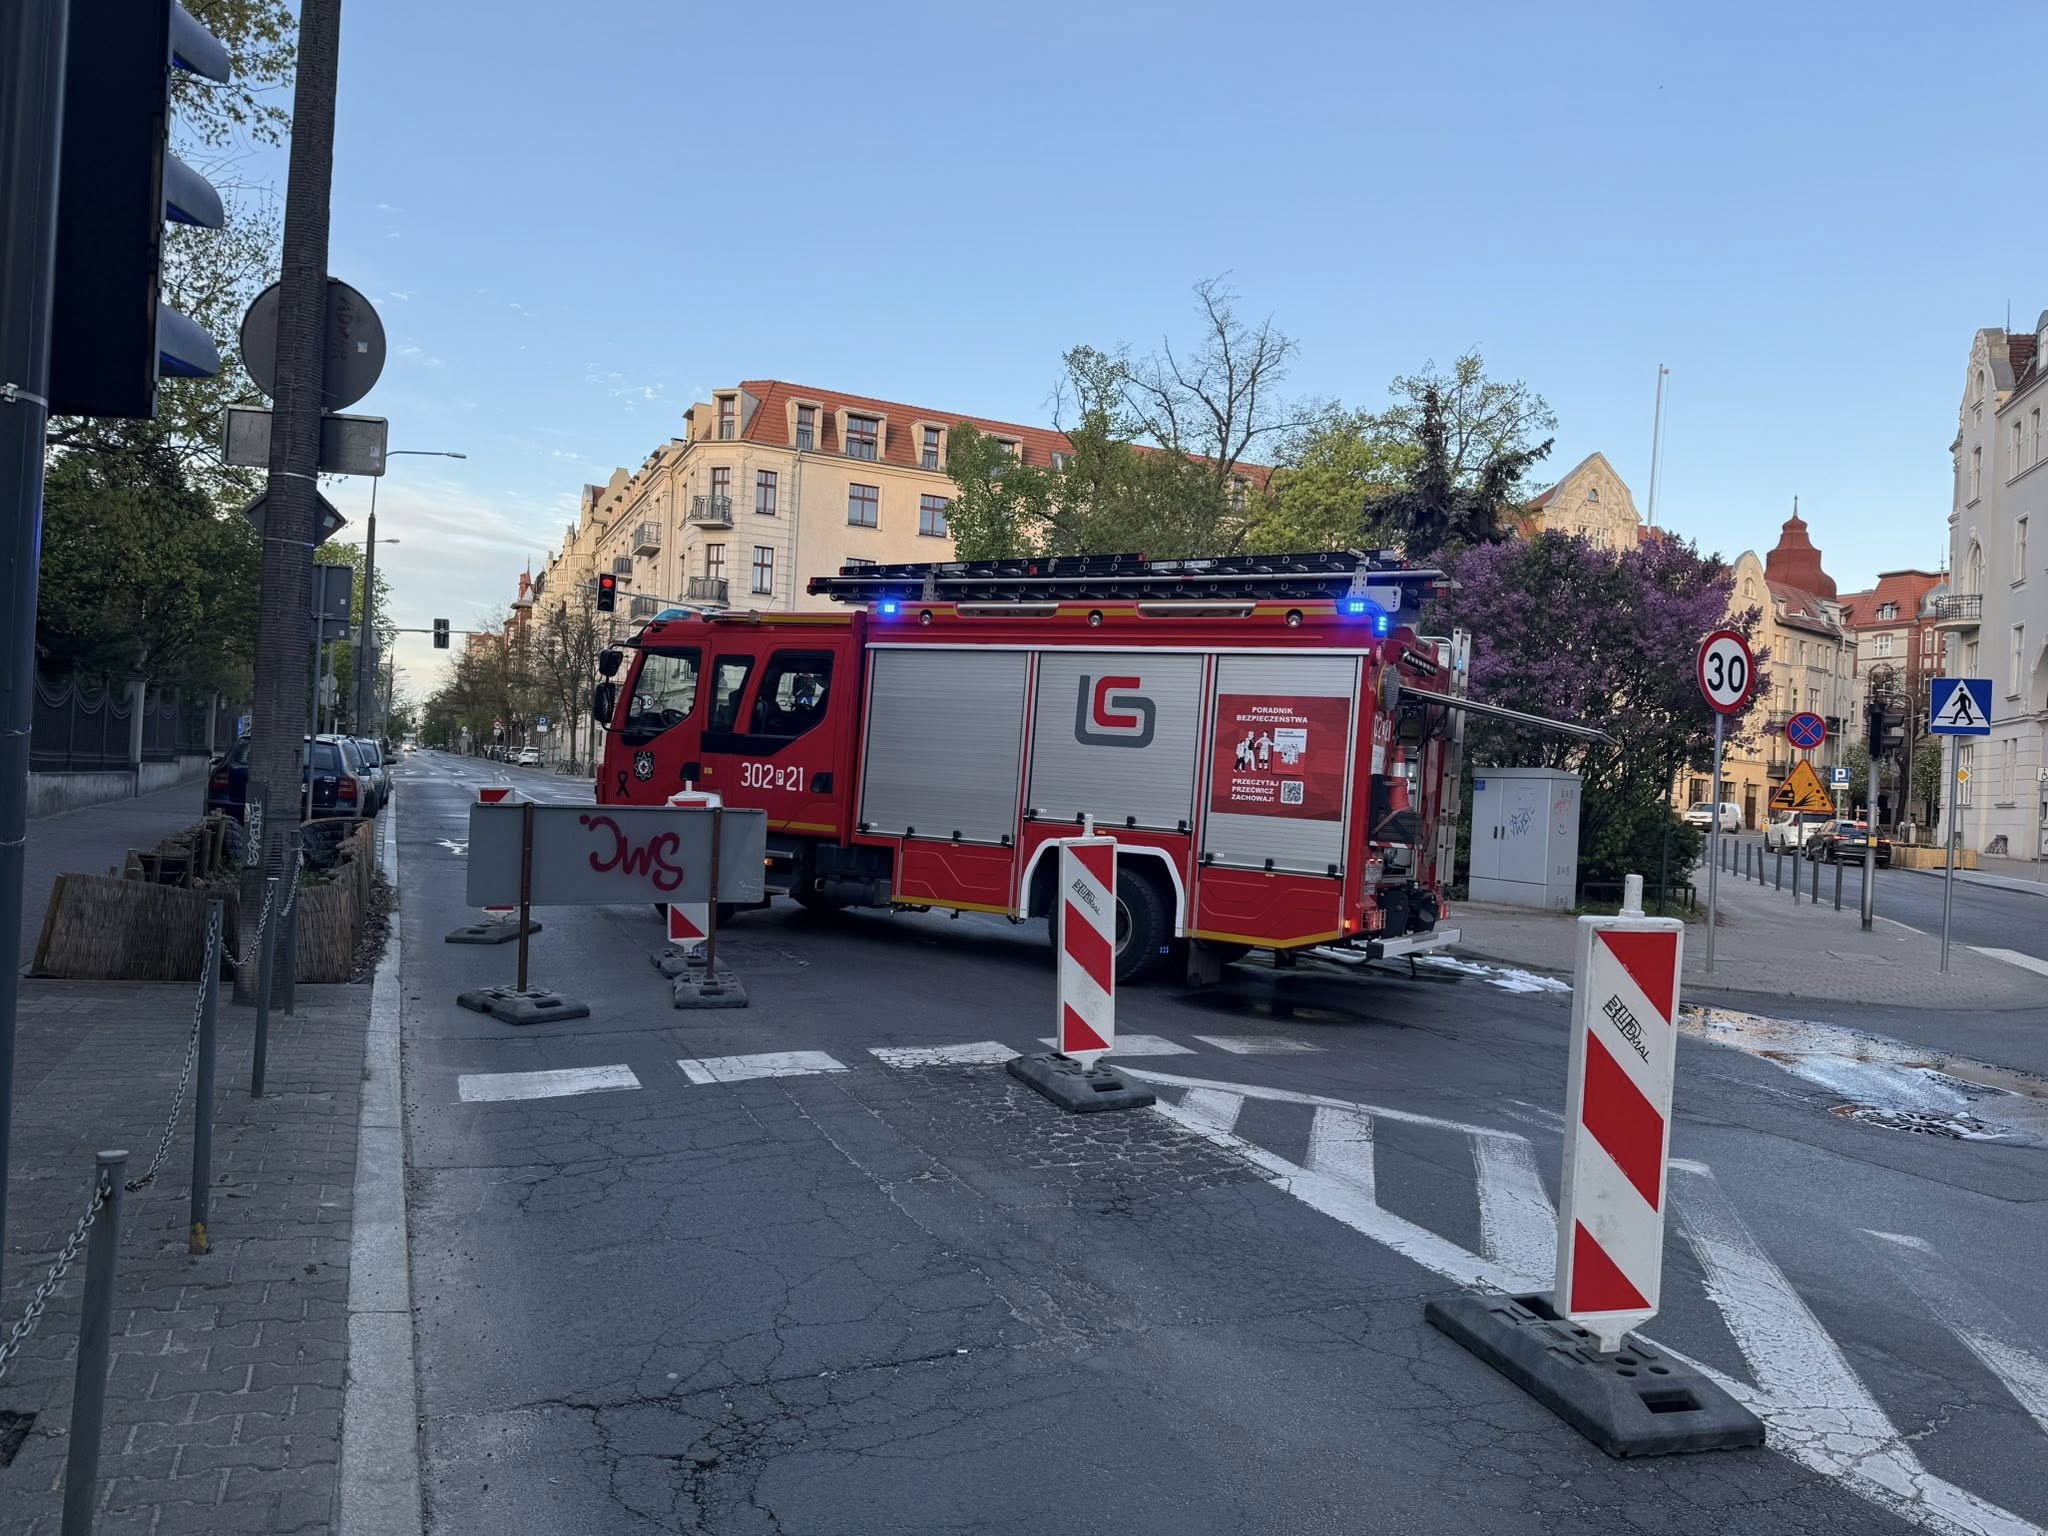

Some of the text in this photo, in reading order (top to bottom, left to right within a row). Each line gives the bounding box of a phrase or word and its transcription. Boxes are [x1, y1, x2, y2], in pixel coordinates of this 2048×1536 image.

[1707, 652, 1745, 693] 30
[1252, 706, 1293, 714] PORADNIK
[1236, 714, 1308, 723] BEZPIECZEŃSTWA
[740, 762, 774, 789] 302
[786, 766, 804, 791] 21
[1835, 768, 1846, 781] P
[1232, 778, 1279, 787] PRZECZYTAJ
[1231, 785, 1274, 794] PRZEĆWICZ
[1231, 794, 1275, 802] ZACHOWAJ!
